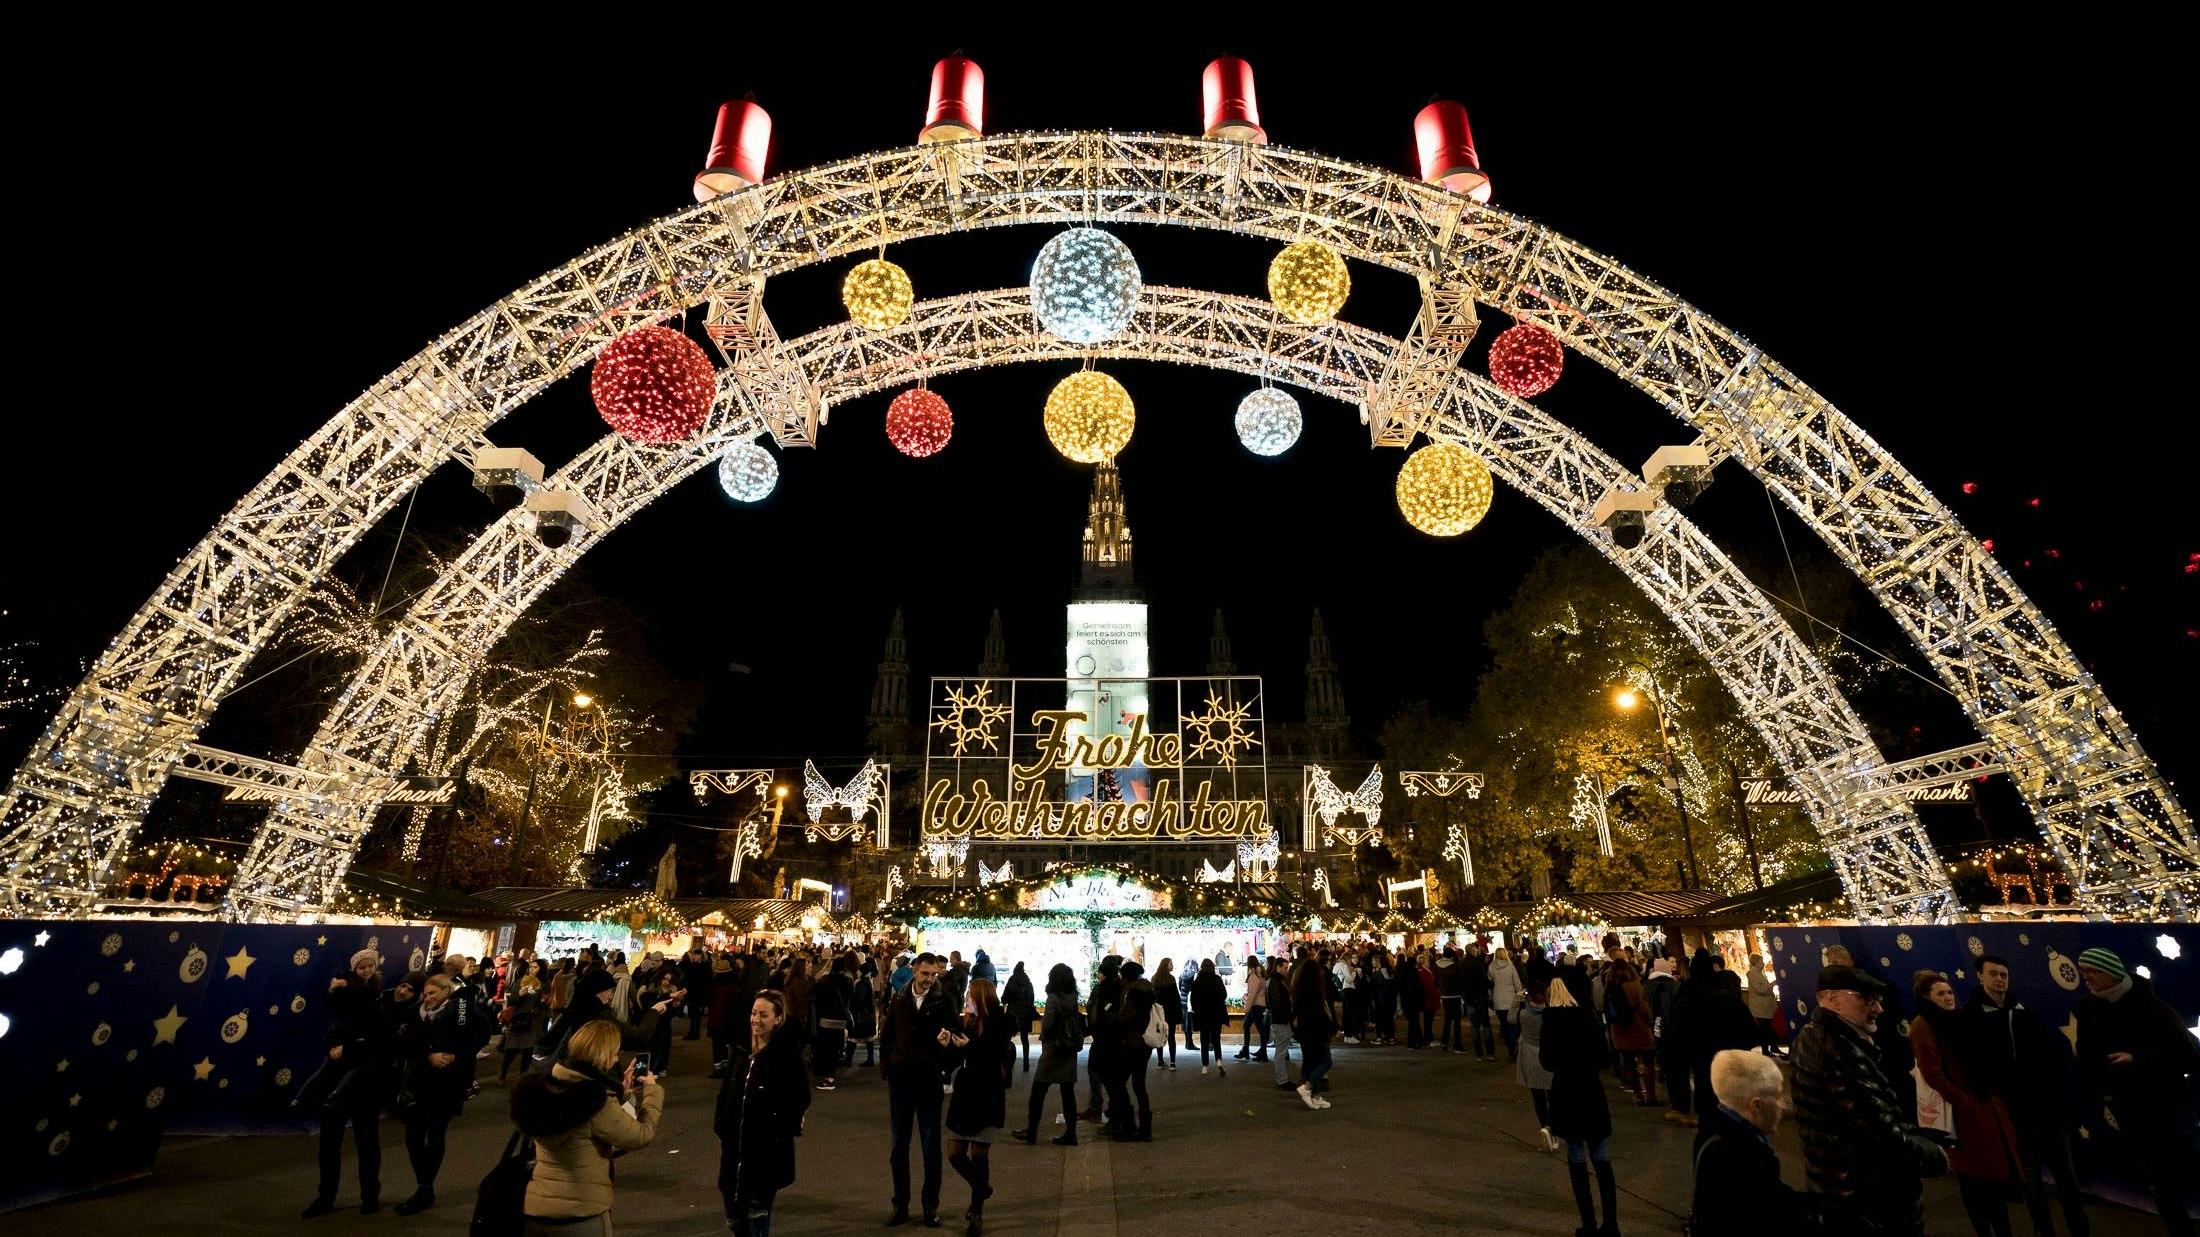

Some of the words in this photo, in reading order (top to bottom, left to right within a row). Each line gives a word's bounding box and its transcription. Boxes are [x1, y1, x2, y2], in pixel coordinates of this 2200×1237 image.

[1086, 638, 1128, 646] schönsten
[1012, 710, 1183, 780] Frohe
[922, 778, 1271, 838] Weihnachten
